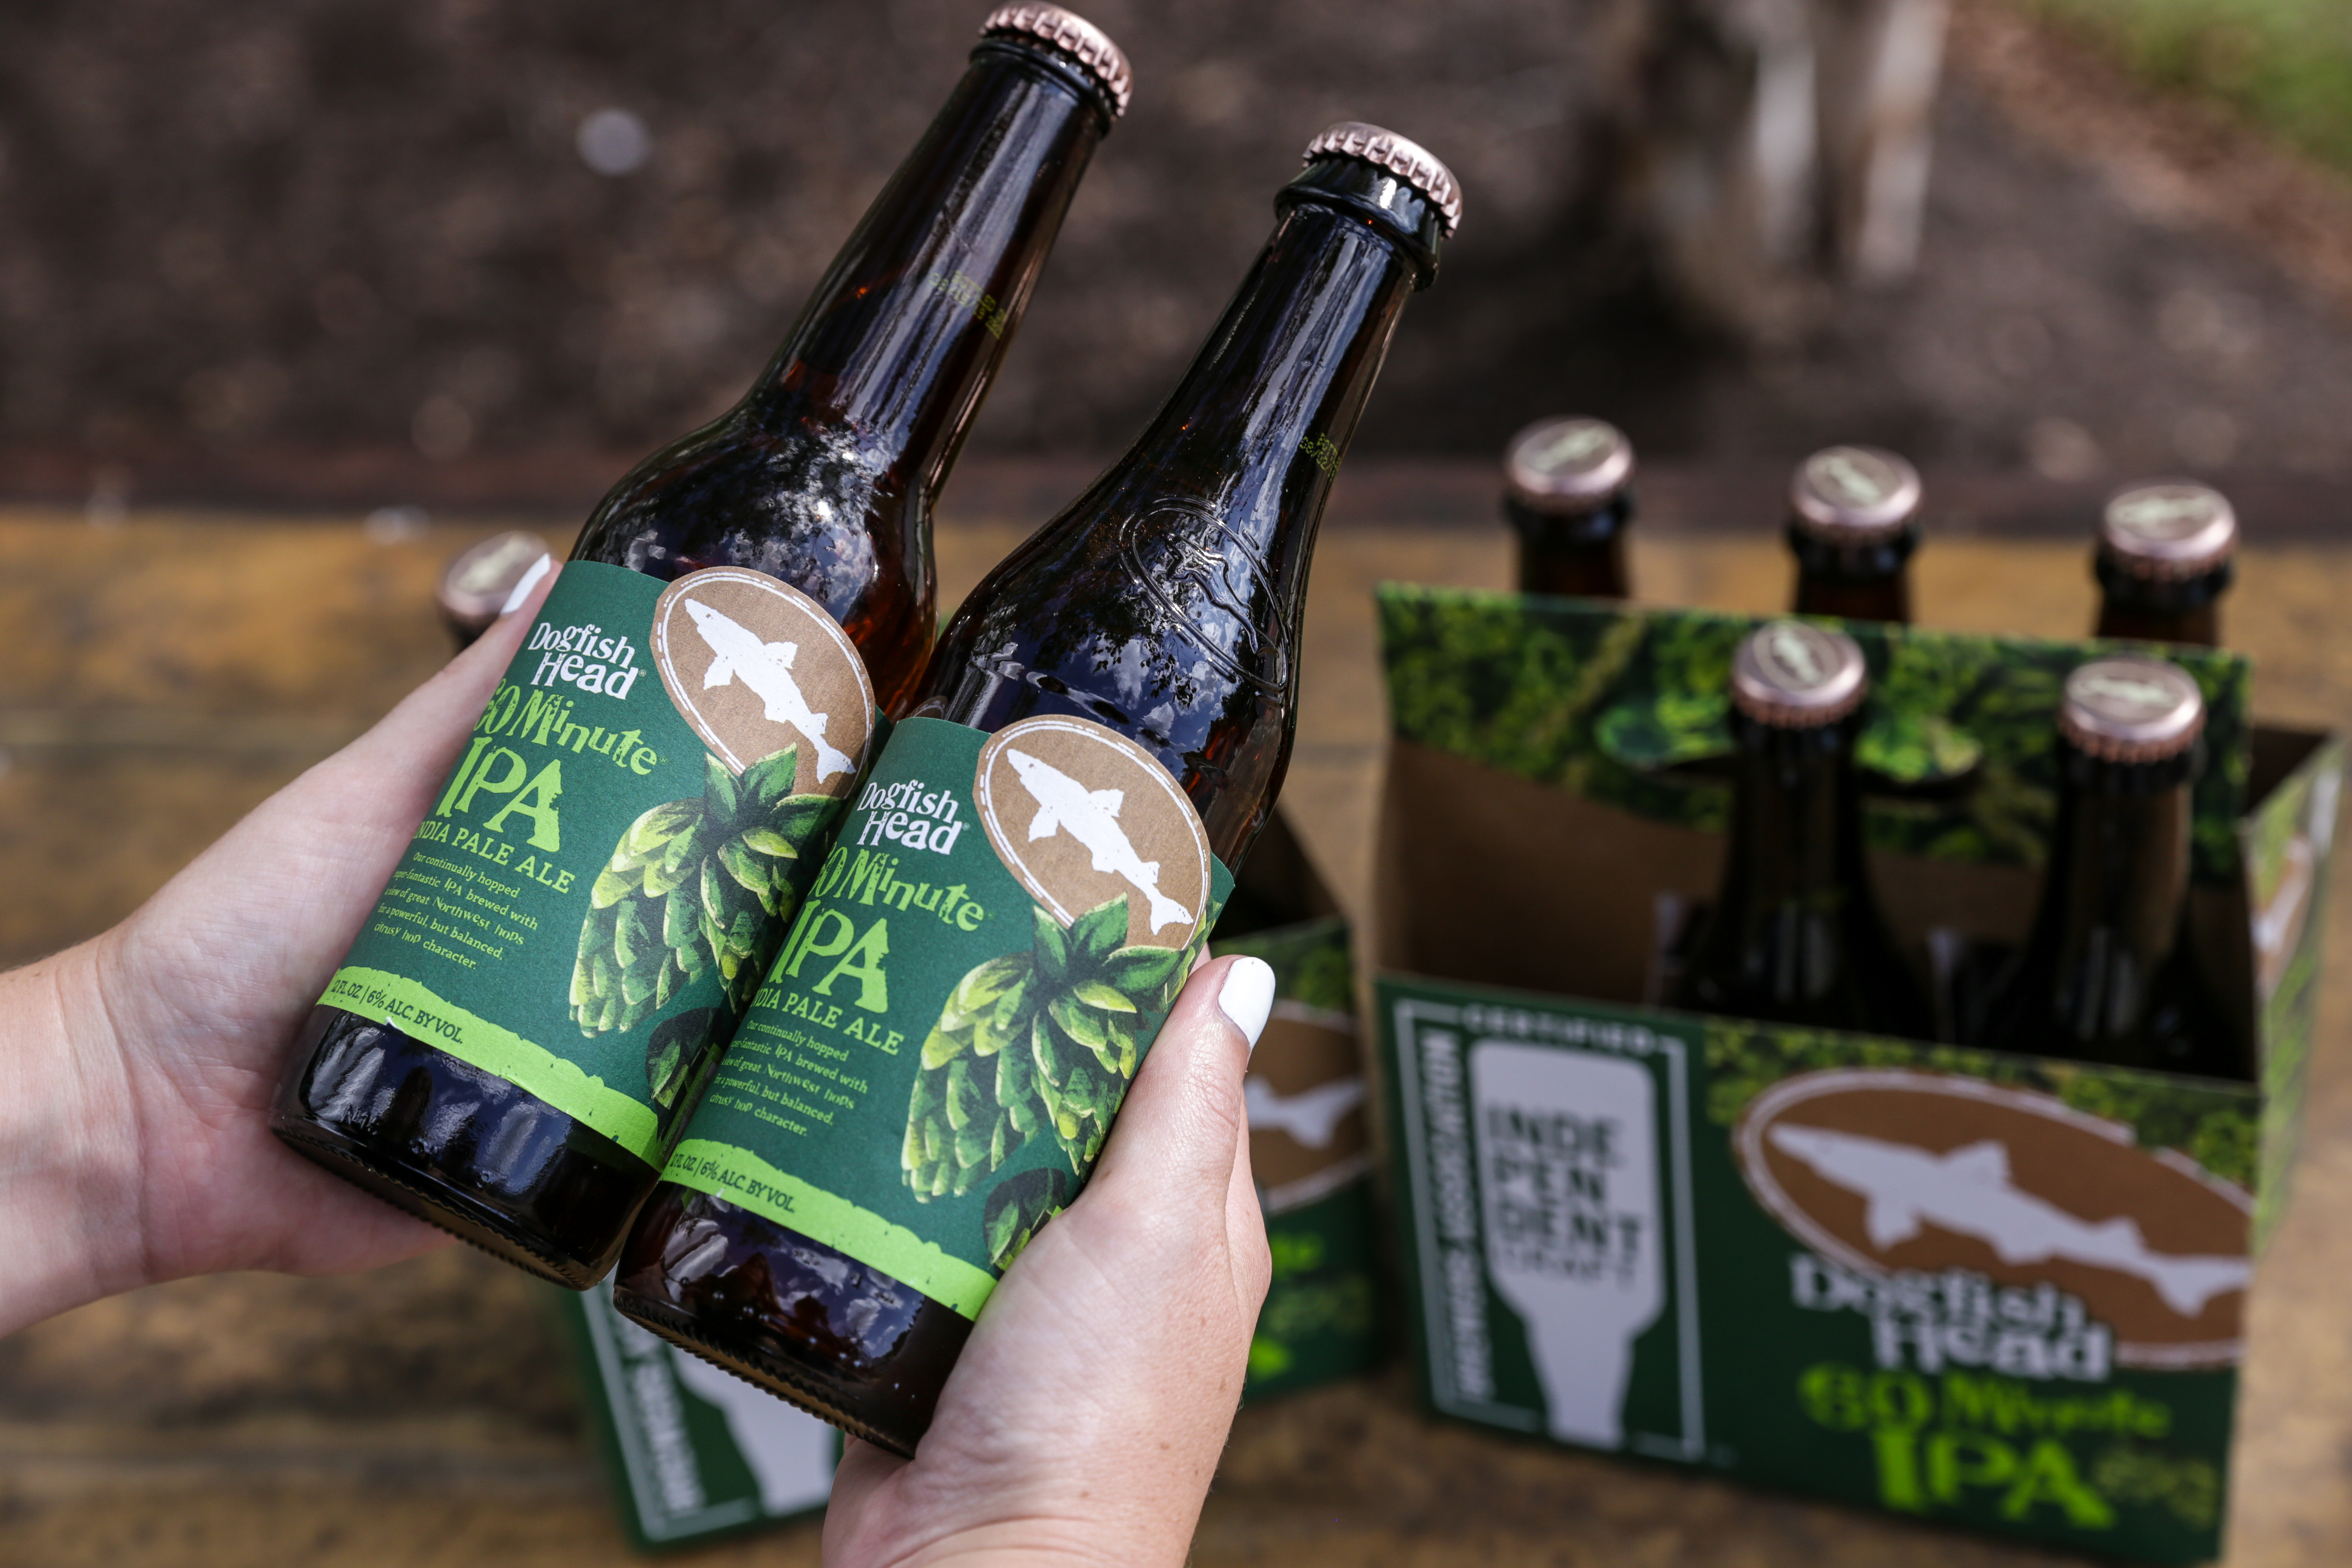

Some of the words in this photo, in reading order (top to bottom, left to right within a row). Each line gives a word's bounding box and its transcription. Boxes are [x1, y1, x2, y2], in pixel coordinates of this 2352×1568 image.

[528, 622, 635, 669] Dogfish
[530, 652, 639, 700] Head
[505, 689, 657, 775] Minute
[436, 736, 563, 852] IPA
[857, 779, 959, 824] Dogfish
[857, 811, 962, 855] Head
[413, 852, 426, 862] Our
[426, 856, 477, 882] continually
[477, 872, 521, 898] hopped
[451, 827, 515, 866] PALE
[514, 855, 576, 894] ALE
[444, 877, 462, 896] IPA
[466, 888, 510, 916] brewed
[510, 911, 538, 931] with
[833, 848, 984, 932] Minute
[377, 903, 387, 913] for
[388, 908, 429, 928] powerful,
[430, 918, 449, 935] but
[450, 926, 503, 961] balanced,
[400, 888, 411, 898] of
[406, 892, 430, 905] great
[432, 896, 491, 930] Northwest
[494, 924, 525, 945] hops
[374, 921, 402, 936] citrusy
[401, 930, 422, 943] hop
[423, 939, 477, 970] character.
[769, 899, 890, 1014] IPA
[367, 989, 387, 1008] 6%
[384, 998, 414, 1021] ALC.
[413, 1006, 436, 1028] BY
[435, 1019, 463, 1044] VOL.
[747, 1020, 759, 1030] Our
[757, 1023, 806, 1047] continually
[806, 1035, 850, 1062] hopped
[749, 988, 781, 1010] NDIA
[781, 992, 843, 1029] PALE
[842, 1017, 905, 1056] ALE
[733, 1056, 744, 1067] of
[738, 1061, 762, 1073] great
[764, 1063, 821, 1095] Northwest
[775, 1044, 793, 1063] IPA
[795, 1053, 840, 1081] brewed
[839, 1074, 868, 1094] with
[710, 1092, 735, 1106] citrusy
[734, 1099, 753, 1112] hop
[754, 1106, 808, 1137] character.
[761, 1085, 781, 1102] but
[823, 1088, 855, 1110] hops
[1488, 1102, 1623, 1164] INDE
[700, 1161, 720, 1180] 6%
[746, 1179, 768, 1198] BY
[767, 1187, 796, 1214] VOL.
[1493, 1155, 1608, 1204] PEN
[1496, 1204, 1642, 1254] DENT
[1789, 1251, 2088, 1330] Dogfish
[1871, 1314, 2113, 1382] Head
[1797, 1362, 1933, 1435] 60
[1941, 1372, 2173, 1439] Minute
[1874, 1430, 2117, 1530] IPA
